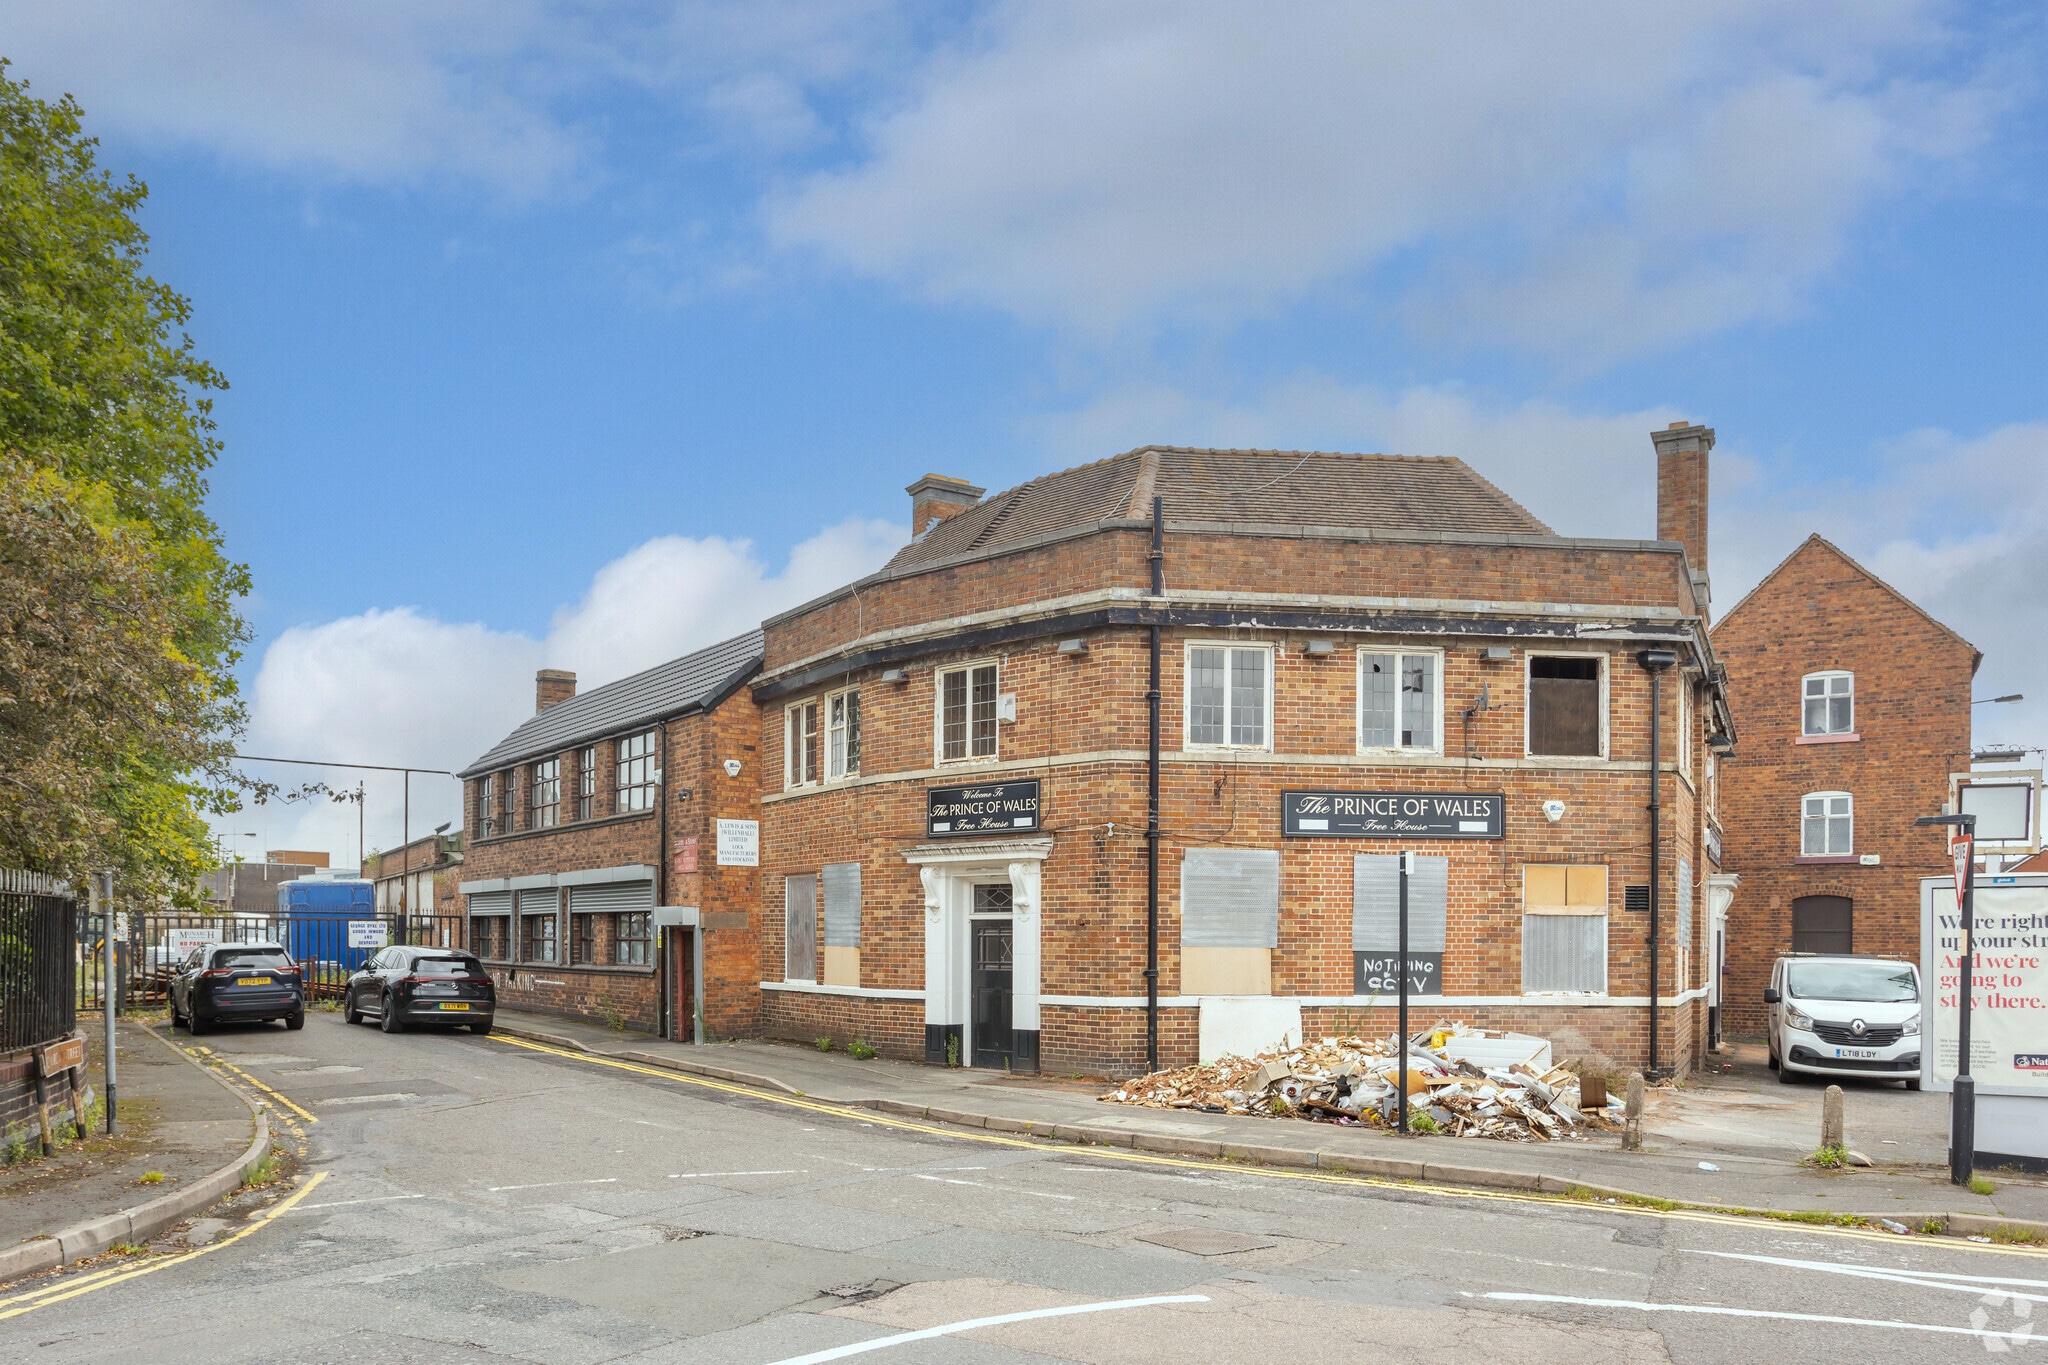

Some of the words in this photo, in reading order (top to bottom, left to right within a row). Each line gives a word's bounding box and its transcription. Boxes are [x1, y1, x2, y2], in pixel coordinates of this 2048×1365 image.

[962, 790, 992, 800] Welcome
[992, 788, 1004, 798] To
[930, 804, 948, 817] The
[950, 802, 984, 816] PRINCE
[986, 800, 1001, 813] OF
[1004, 798, 1036, 812] WALES
[1296, 796, 1332, 814] The
[1334, 798, 1398, 816] PRINCE
[1404, 799, 1429, 816] OF
[1434, 800, 1491, 816] WALES
[955, 819, 976, 831] Free
[978, 817, 1009, 830] House
[1362, 819, 1388, 831] Free
[1390, 819, 1428, 831] House
[1954, 844, 1966, 860] GIVE
[1939, 915, 1994, 930] Wre
[1364, 958, 1382, 973] NO
[1384, 958, 1434, 973] TIING
[1986, 954, 2040, 968] we're
[492, 972, 500, 988] NO
[1940, 974, 1998, 990] gong
[2003, 974, 2023, 987] to
[1940, 994, 1982, 1010] sty
[1987, 992, 2046, 1009] there.
